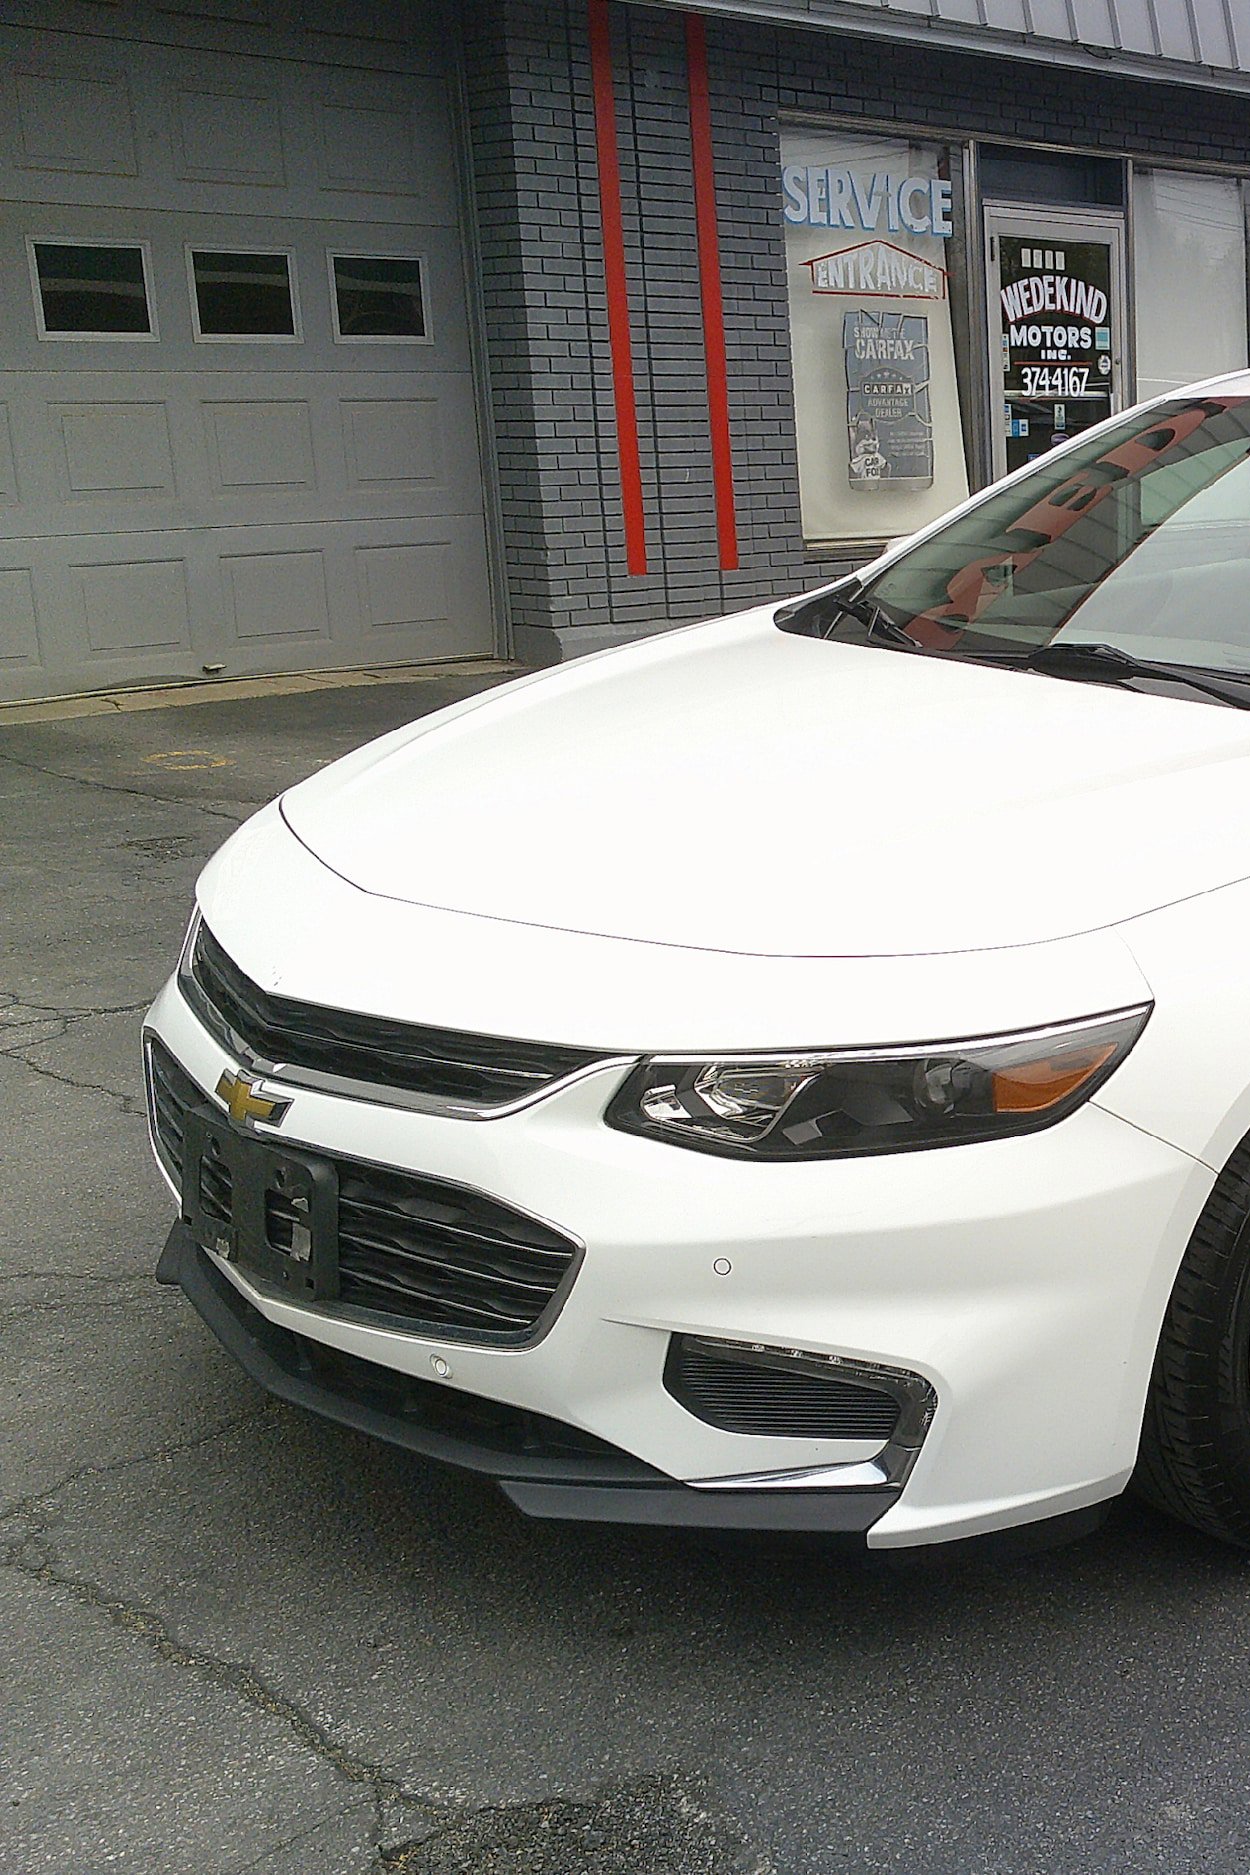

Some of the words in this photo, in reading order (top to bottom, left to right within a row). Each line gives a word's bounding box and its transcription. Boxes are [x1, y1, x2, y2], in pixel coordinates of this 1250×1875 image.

[781, 165, 952, 238] SERVICE
[816, 245, 938, 293] ENTRANCE
[1001, 275, 1108, 325] WEDEKIND
[855, 339, 914, 360] CARFAX
[1010, 325, 1092, 349] MOTORS
[1040, 349, 1072, 361] INC.
[864, 383, 912, 395] CARFAX
[1021, 367, 1090, 398] 374-4167
